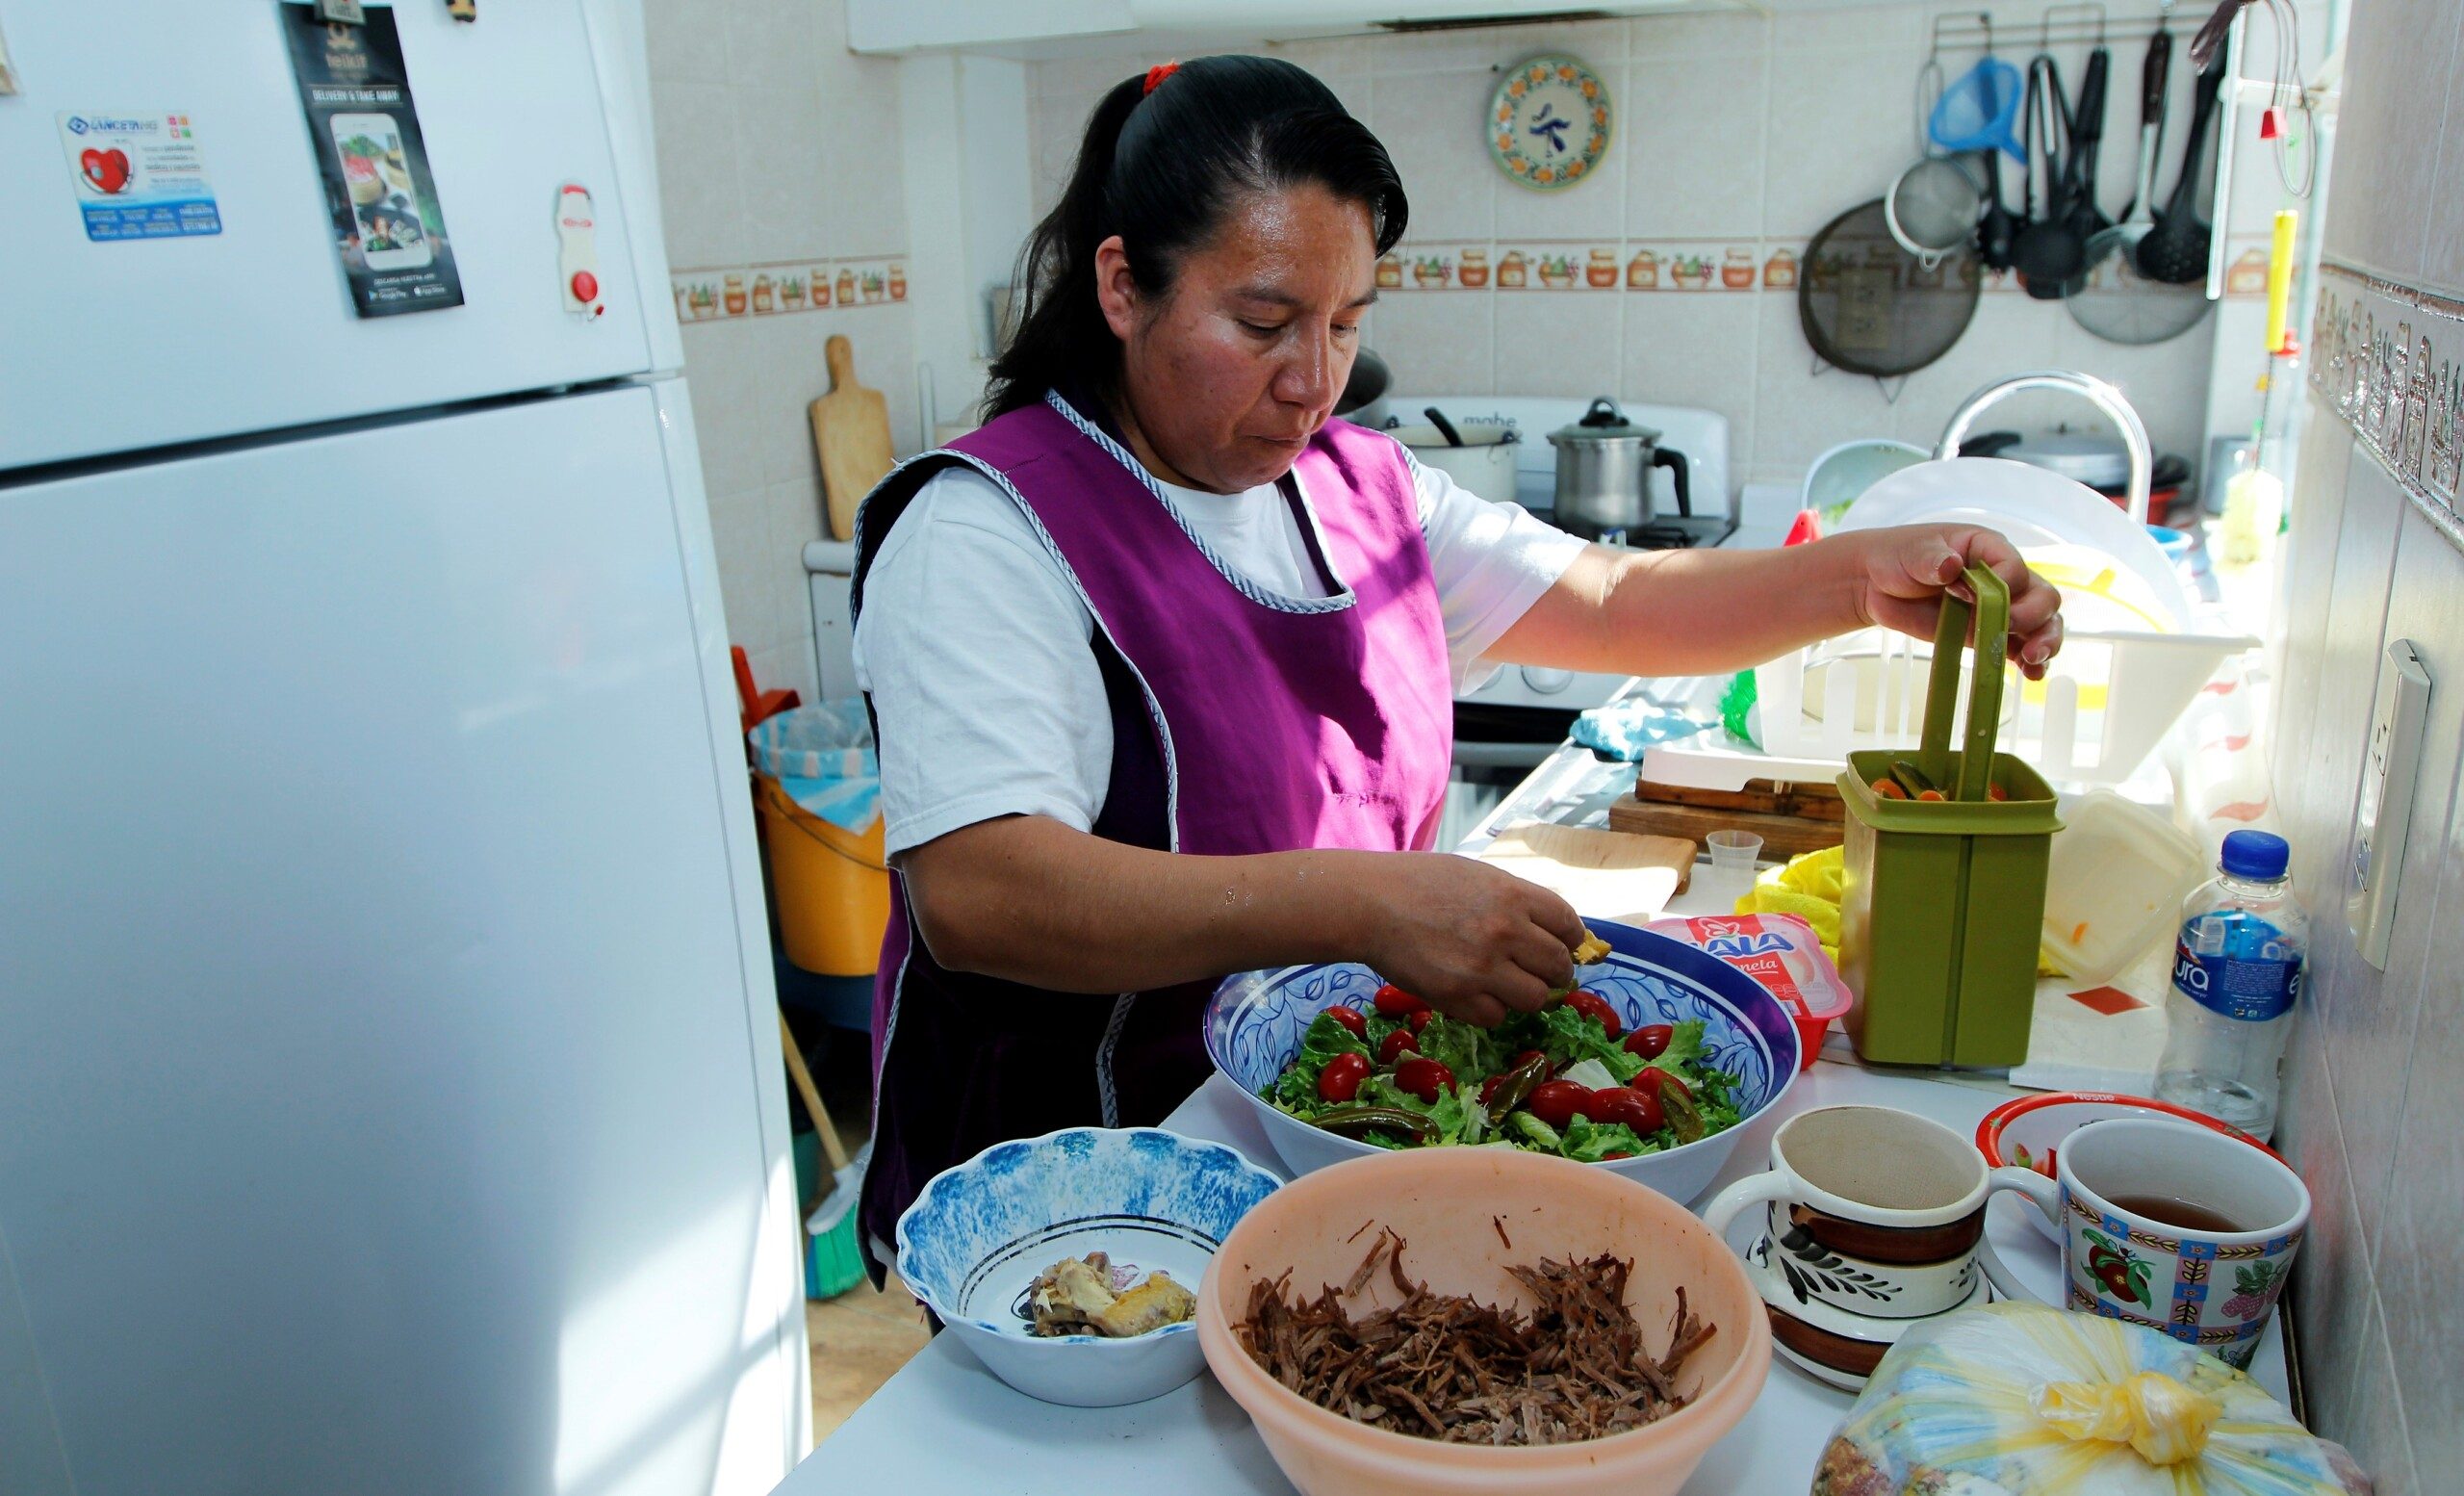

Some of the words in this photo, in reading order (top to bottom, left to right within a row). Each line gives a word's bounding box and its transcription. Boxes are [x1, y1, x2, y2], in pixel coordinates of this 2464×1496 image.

[312, 90, 346, 101] DELIVERY
[347, 90, 355, 101] &
[355, 90, 375, 102] TAKE
[375, 90, 399, 102] AWAY
[1690, 933, 1794, 957] ALA
[1735, 959, 1779, 972] nela
[2175, 954, 2209, 991] ura
